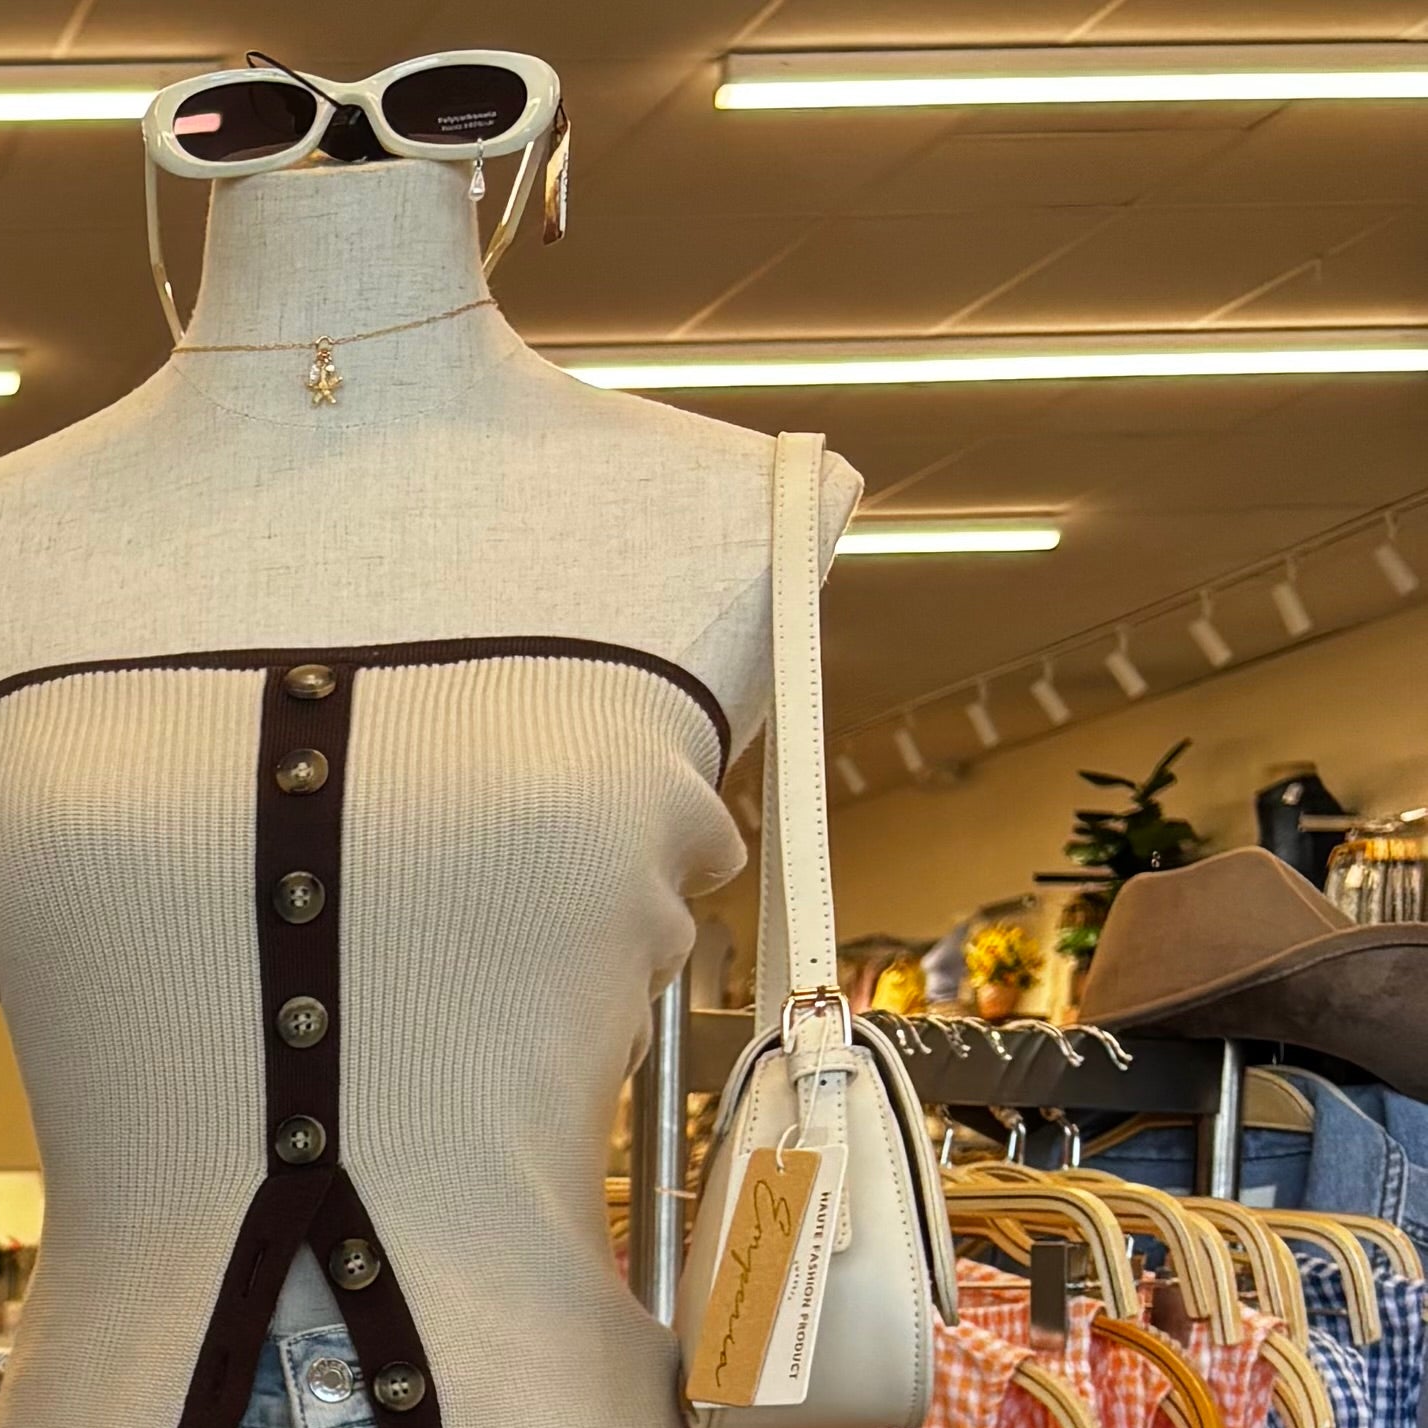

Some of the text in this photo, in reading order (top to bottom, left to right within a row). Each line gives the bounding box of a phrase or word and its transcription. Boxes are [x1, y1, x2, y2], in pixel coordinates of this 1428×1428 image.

[813, 1191, 832, 1239] HAUTE
[802, 1244, 821, 1308] FASHION
[789, 1312, 810, 1380] PRODUCT
